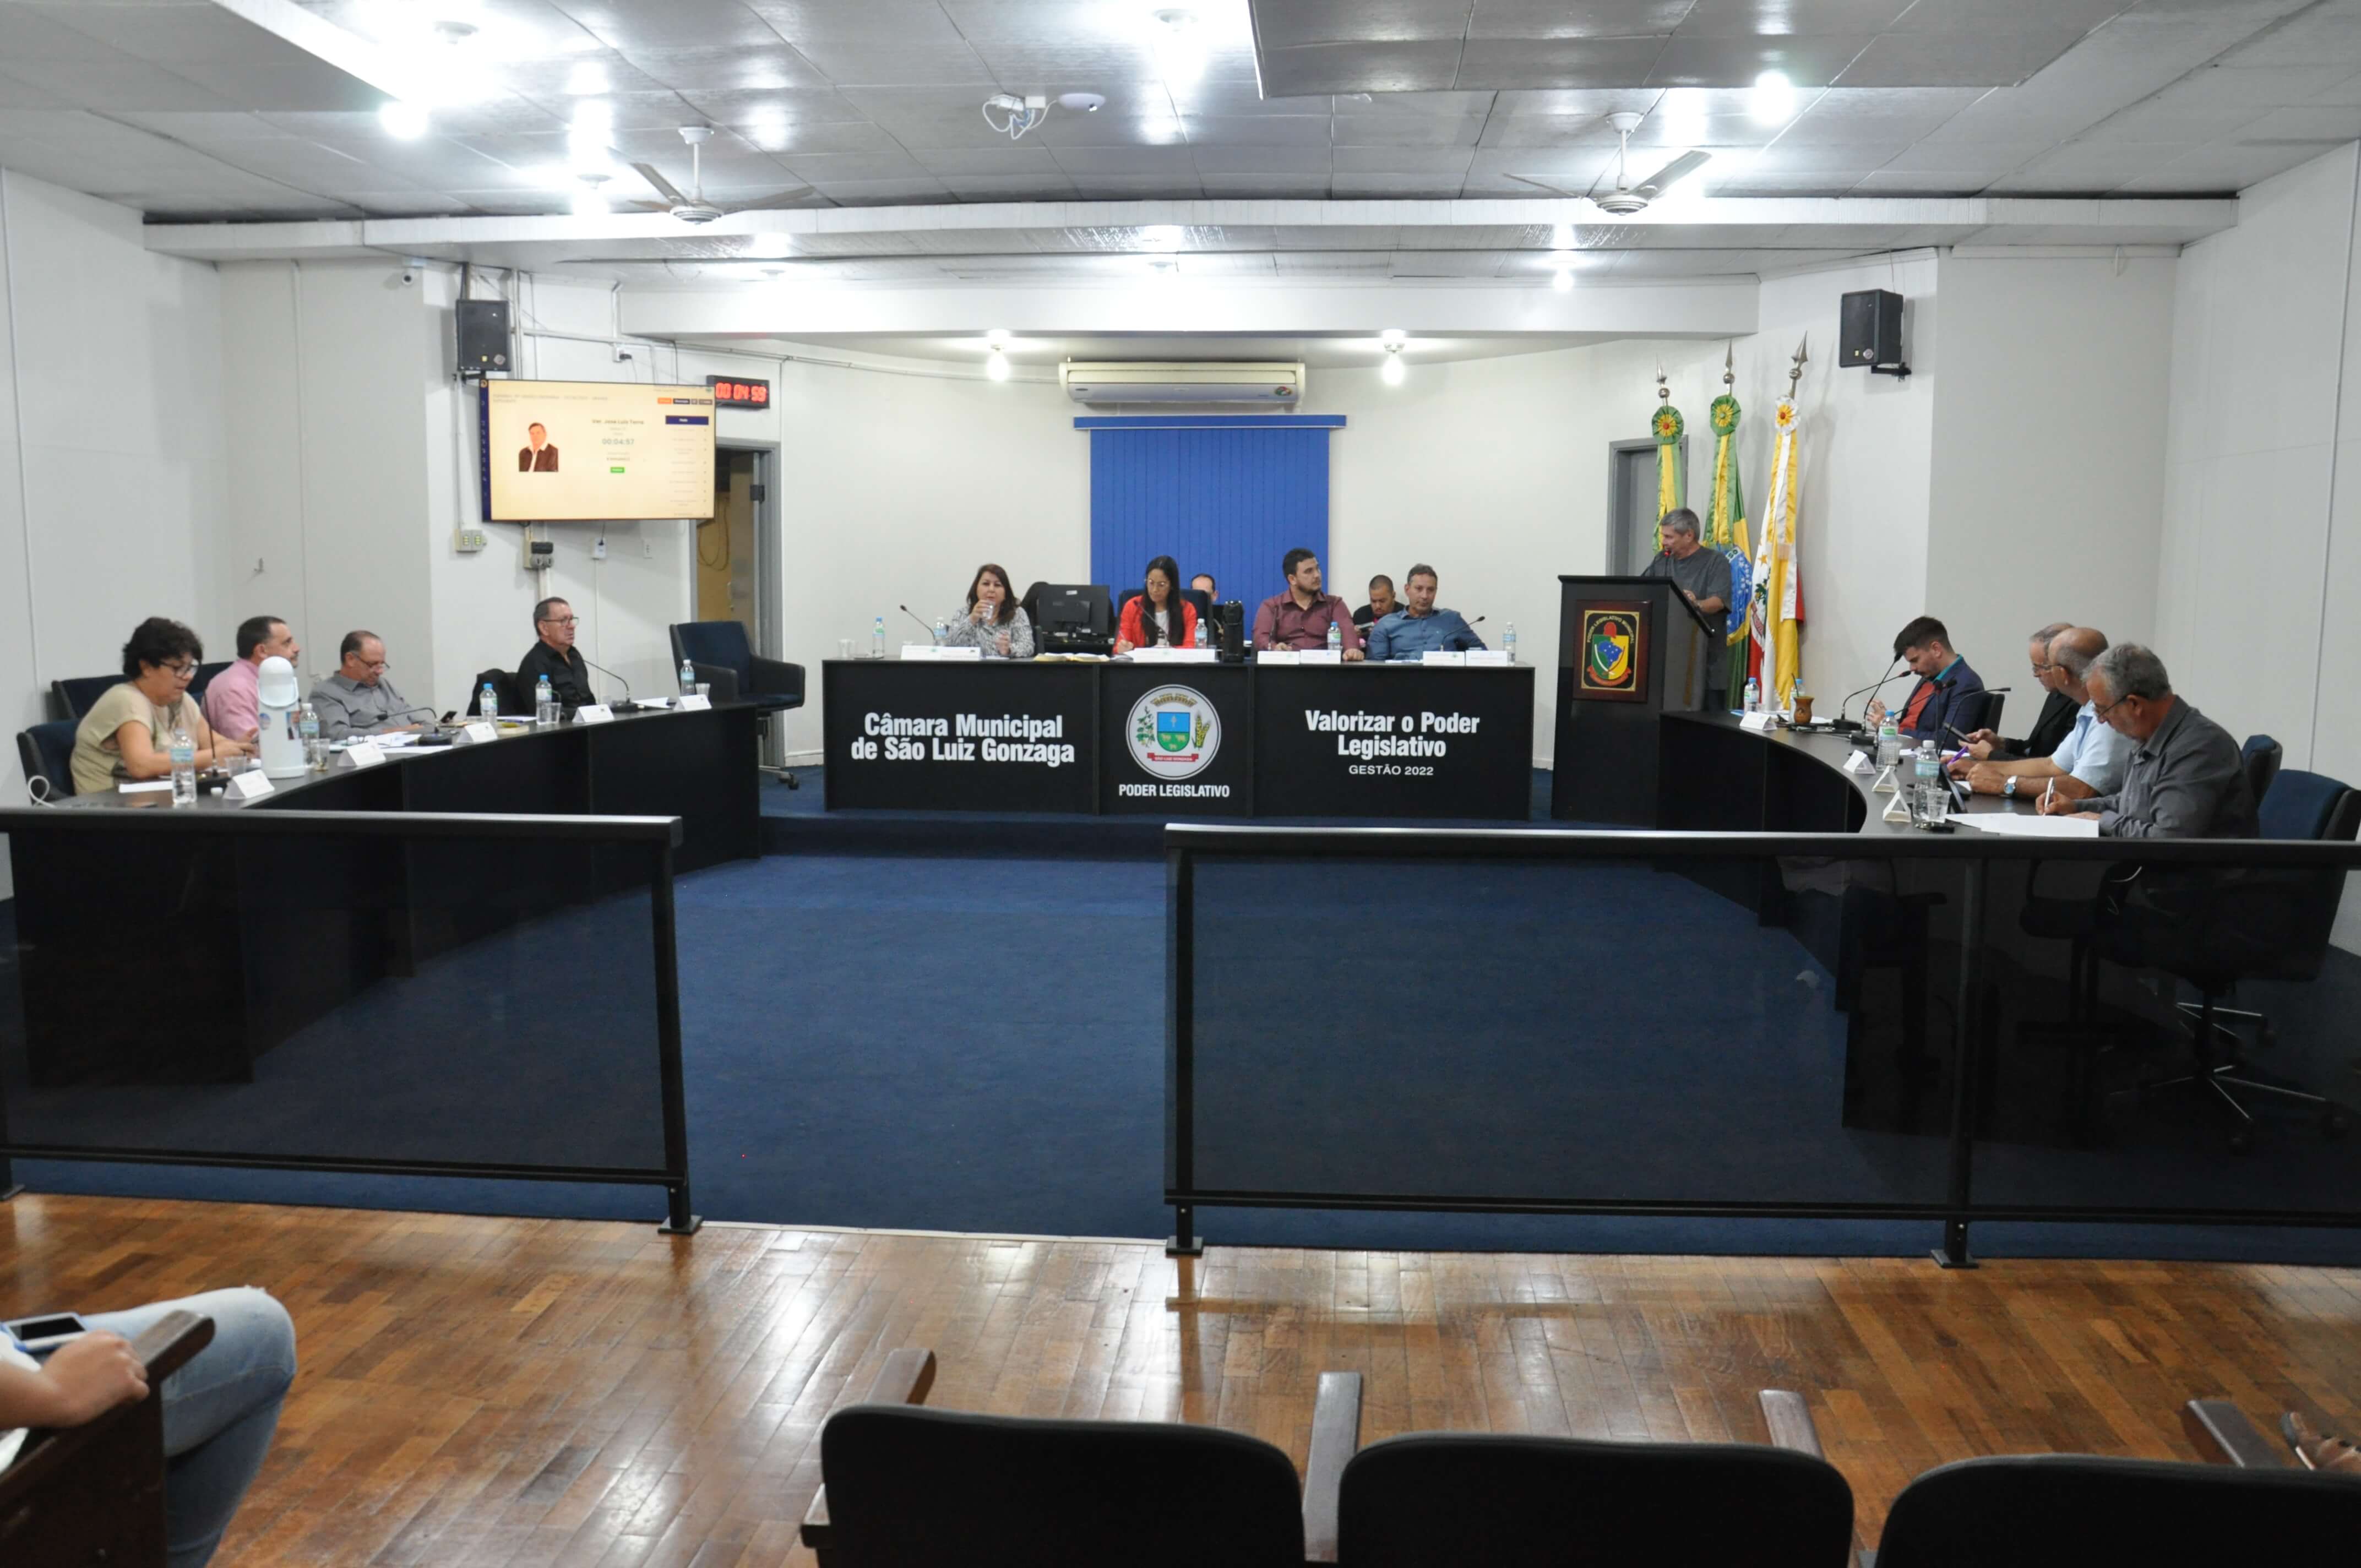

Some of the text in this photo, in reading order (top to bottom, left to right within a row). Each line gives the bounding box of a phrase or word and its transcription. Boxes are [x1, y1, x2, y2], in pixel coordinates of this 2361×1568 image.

[864, 712, 1063, 743] Câmara Municipal
[1305, 710, 1480, 733] Valorizar o Poder
[851, 737, 1075, 767] de São Luiz Gonzaga
[1338, 734, 1446, 760] Legislativo
[1348, 764, 1434, 776] GESTÃO 2022
[1119, 783, 1230, 798] PODER LEGISLATIVO
